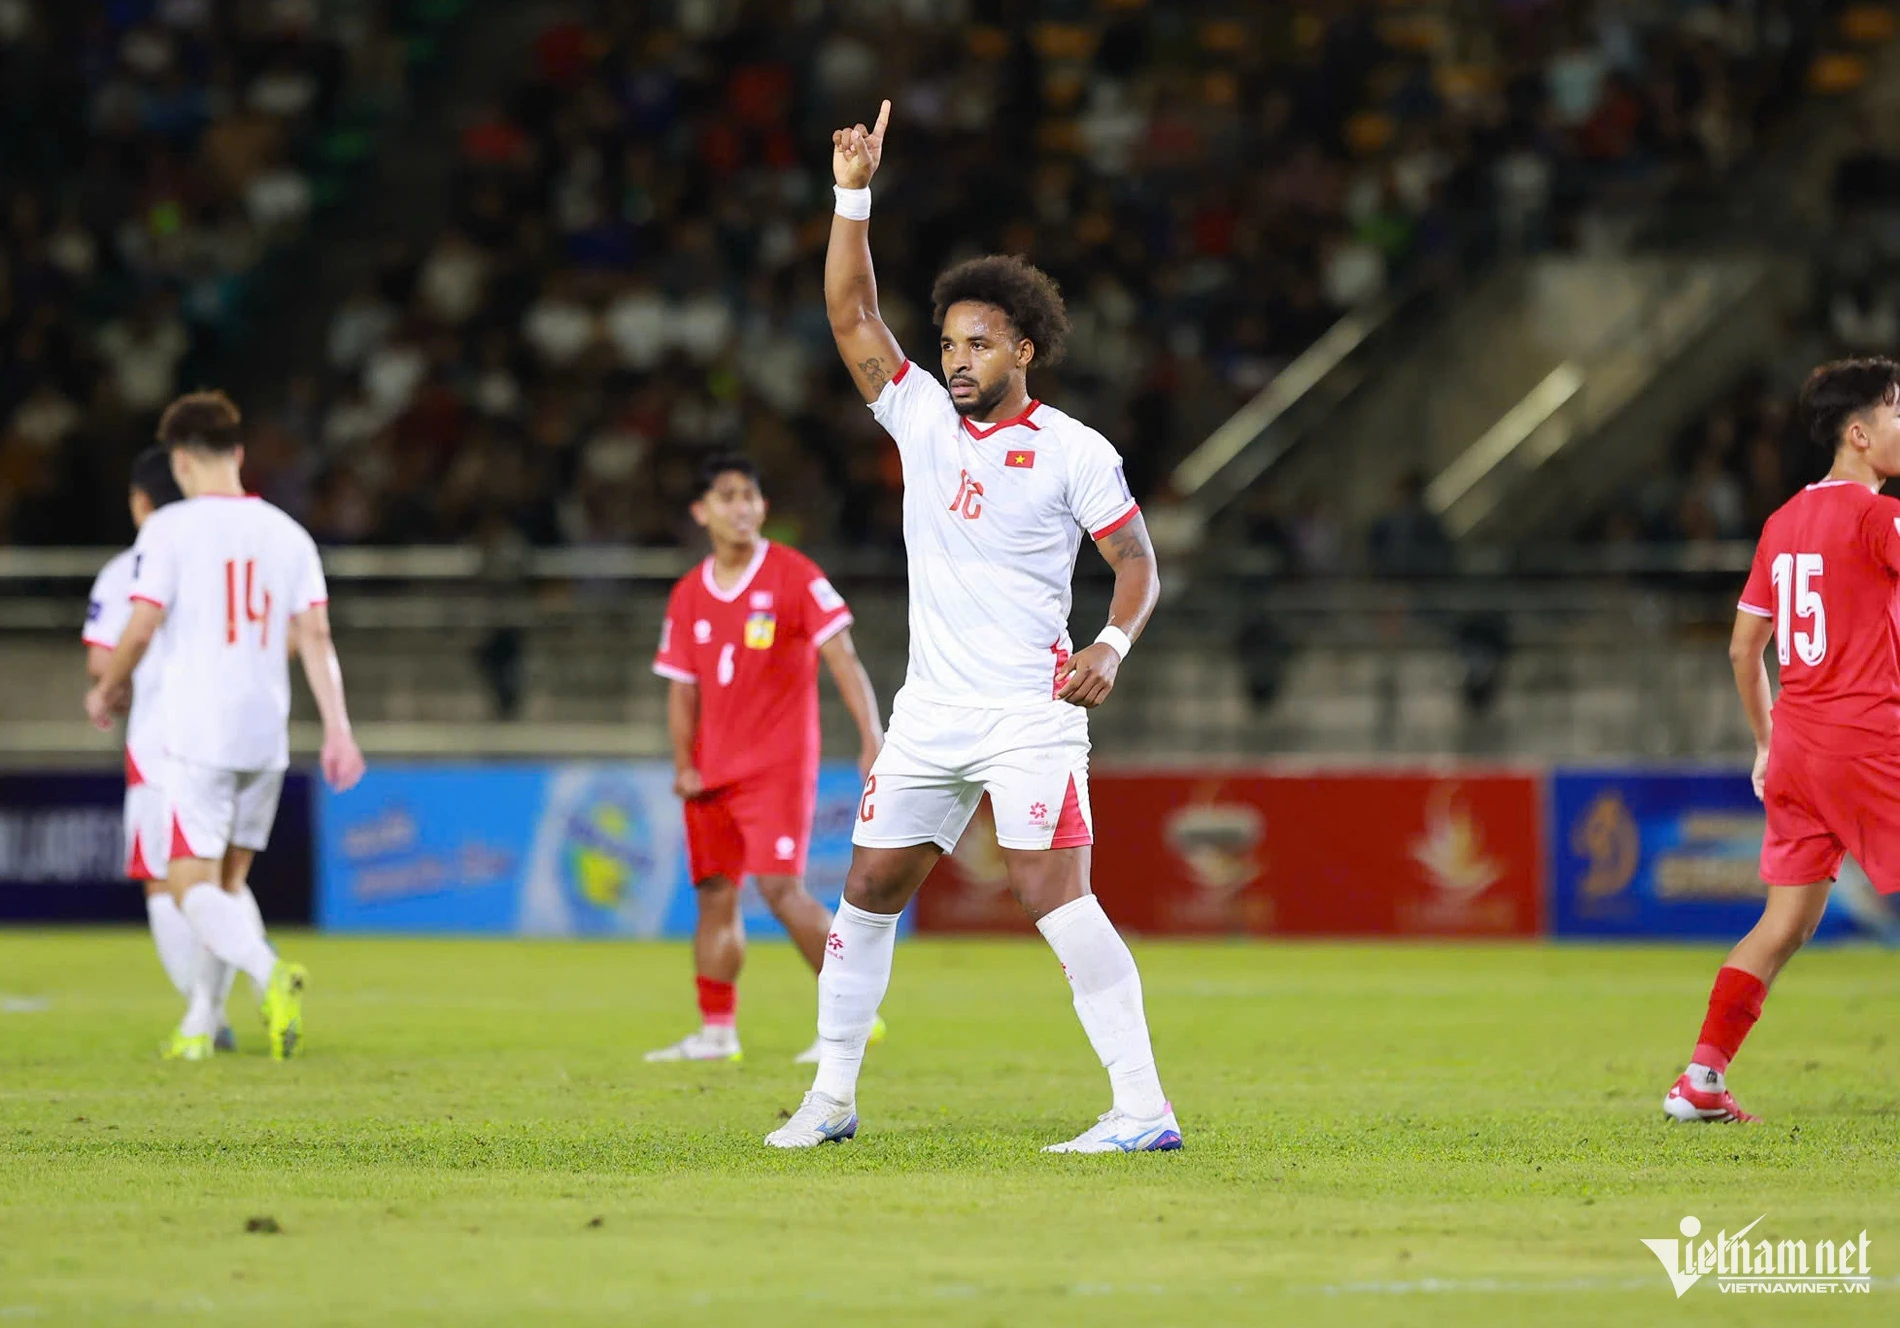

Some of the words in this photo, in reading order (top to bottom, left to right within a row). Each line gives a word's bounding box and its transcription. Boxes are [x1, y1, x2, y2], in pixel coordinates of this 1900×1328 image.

[225, 559, 271, 648] 14
[1771, 552, 1827, 666] 15
[717, 642, 735, 687] 6
[857, 774, 876, 823] 2
